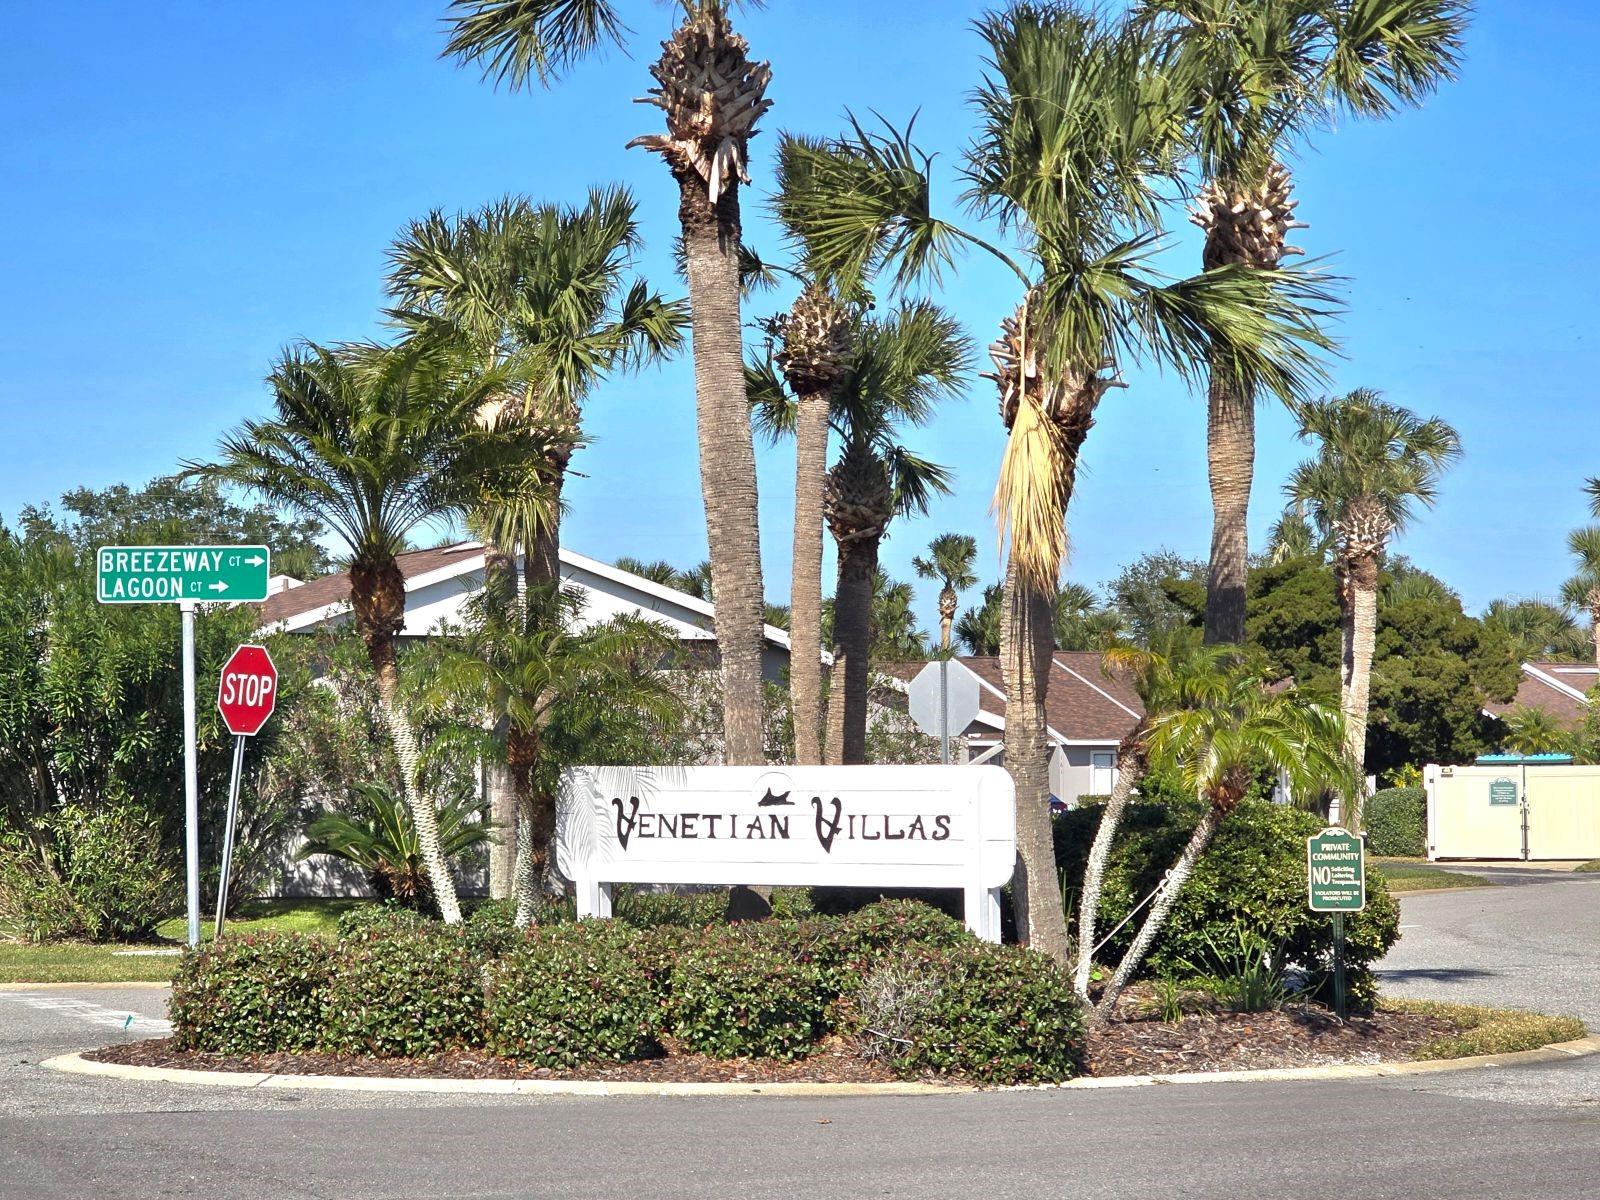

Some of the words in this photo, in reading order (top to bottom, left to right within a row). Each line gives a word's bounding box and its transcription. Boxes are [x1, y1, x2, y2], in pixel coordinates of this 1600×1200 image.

[101, 551, 224, 573] BREEZEWAY
[229, 556, 241, 566] CT
[101, 577, 183, 598] LAGOON
[190, 581, 202, 592] CT
[223, 673, 272, 707] STOP
[612, 797, 790, 851] VENETIAN
[811, 797, 952, 853] VILLAS
[1312, 852, 1360, 860] COMMUNITY
[1321, 843, 1350, 851] PRIVATE
[1312, 866, 1331, 885] NO
